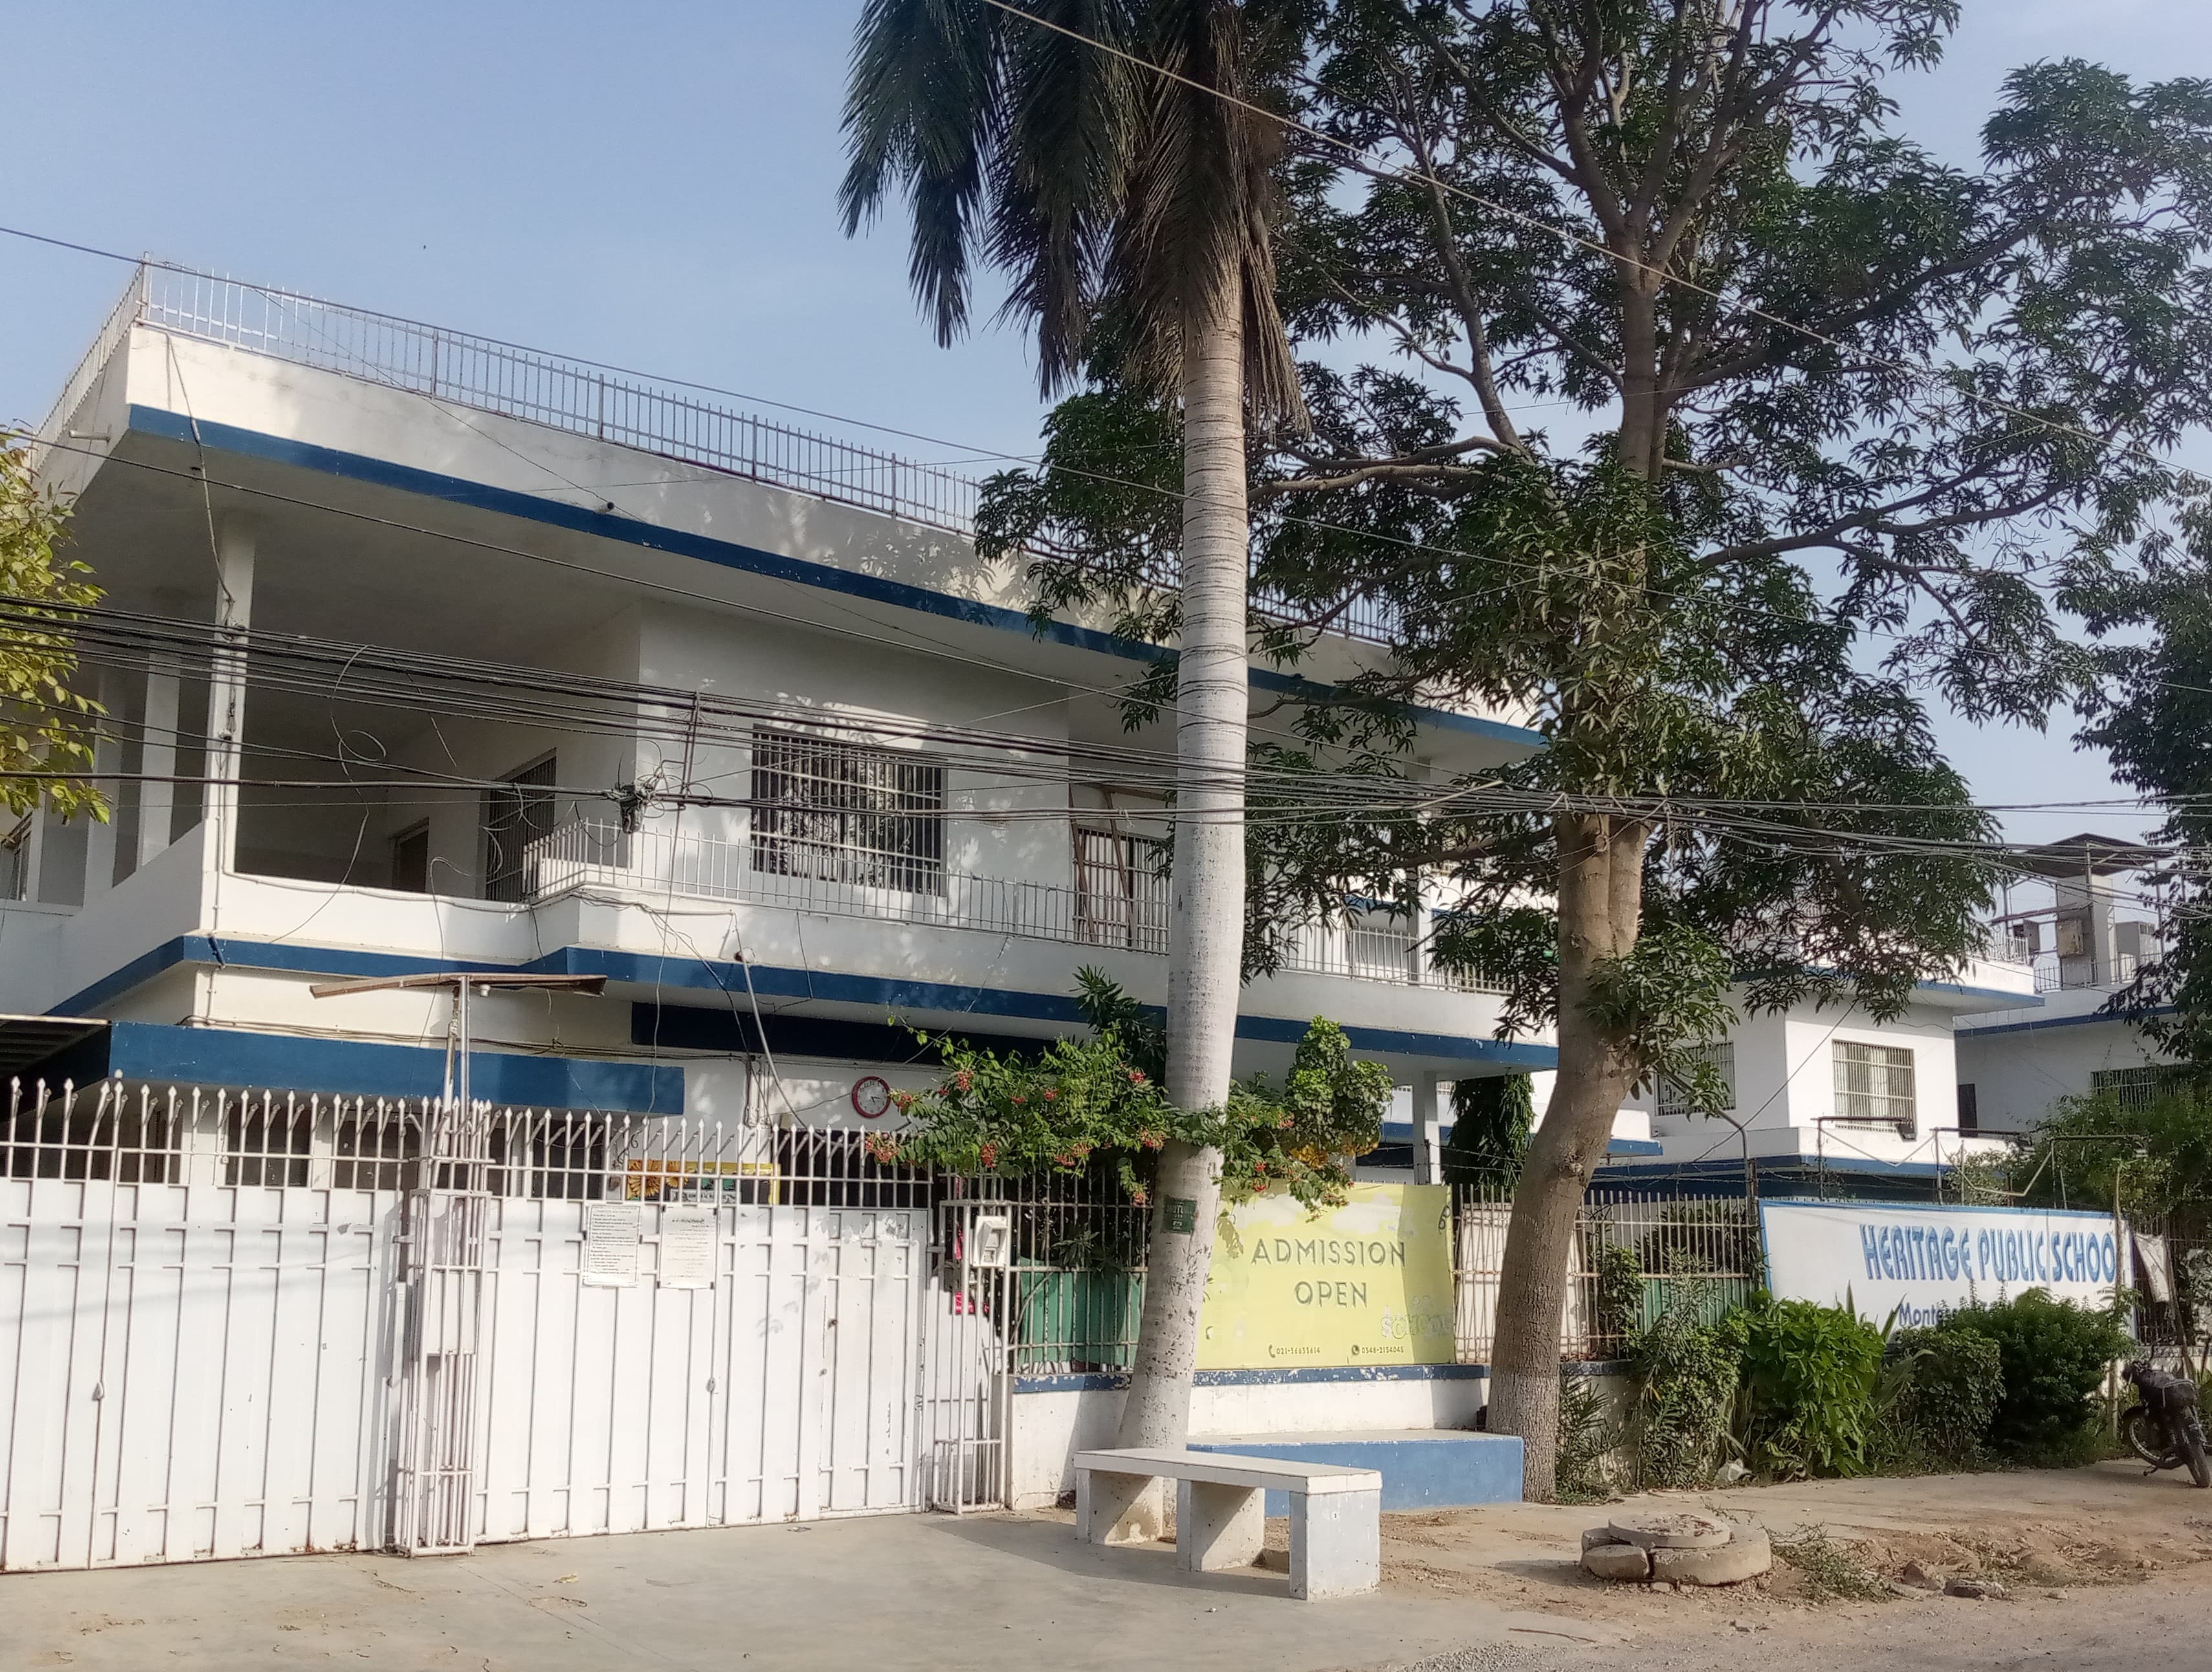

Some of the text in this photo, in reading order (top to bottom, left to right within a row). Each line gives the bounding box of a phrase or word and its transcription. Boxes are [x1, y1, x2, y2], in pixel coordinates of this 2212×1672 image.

[1251, 1238, 1406, 1267] ADMISSION
[1859, 1224, 2125, 1283] HERITAGE PUBLIC SCHOO
[1294, 1280, 1368, 1308] OPEN
